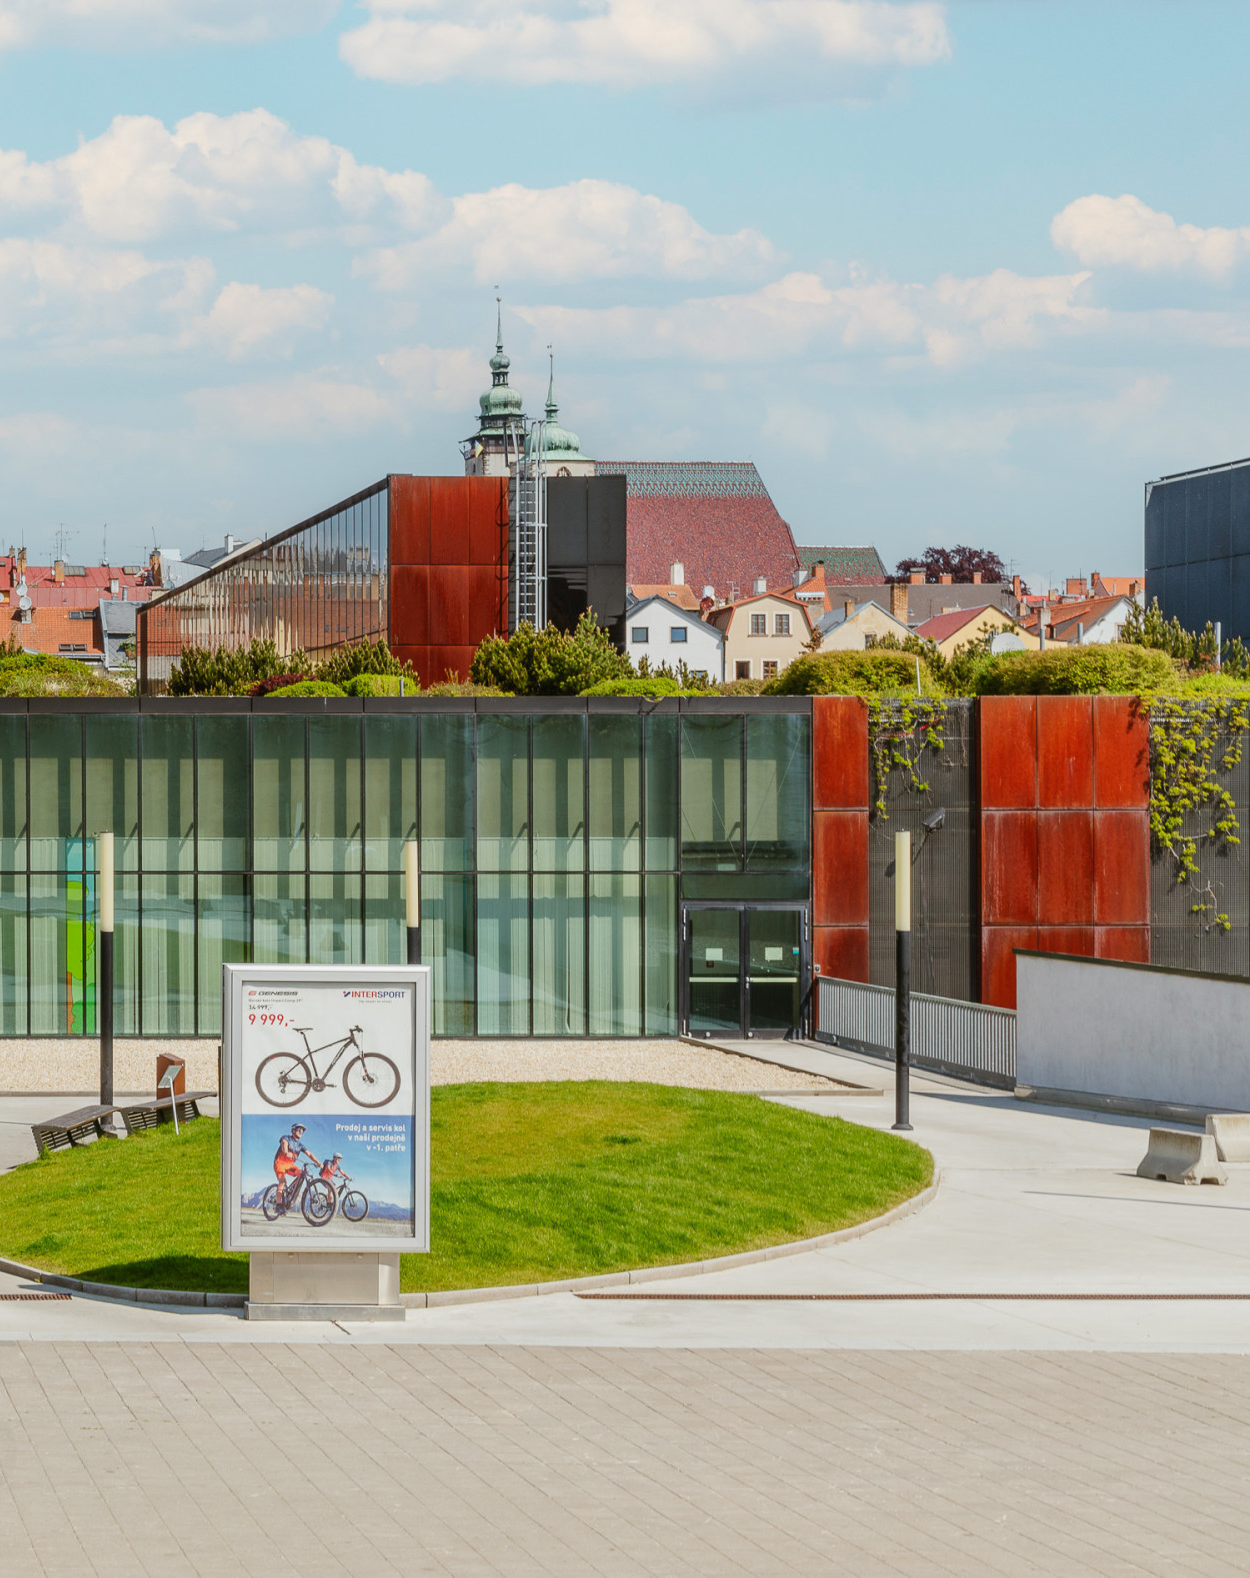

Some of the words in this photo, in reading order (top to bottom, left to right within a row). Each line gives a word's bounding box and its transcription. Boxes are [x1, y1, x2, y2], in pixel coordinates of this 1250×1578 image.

[248, 1013, 256, 1025] 9
[260, 1013, 294, 1027] 999,-
[336, 1123, 361, 1132] Prodej
[369, 1123, 392, 1132] servis
[393, 1123, 406, 1132] kol
[371, 1133, 406, 1143] prodejně
[385, 1143, 406, 1153] patře
